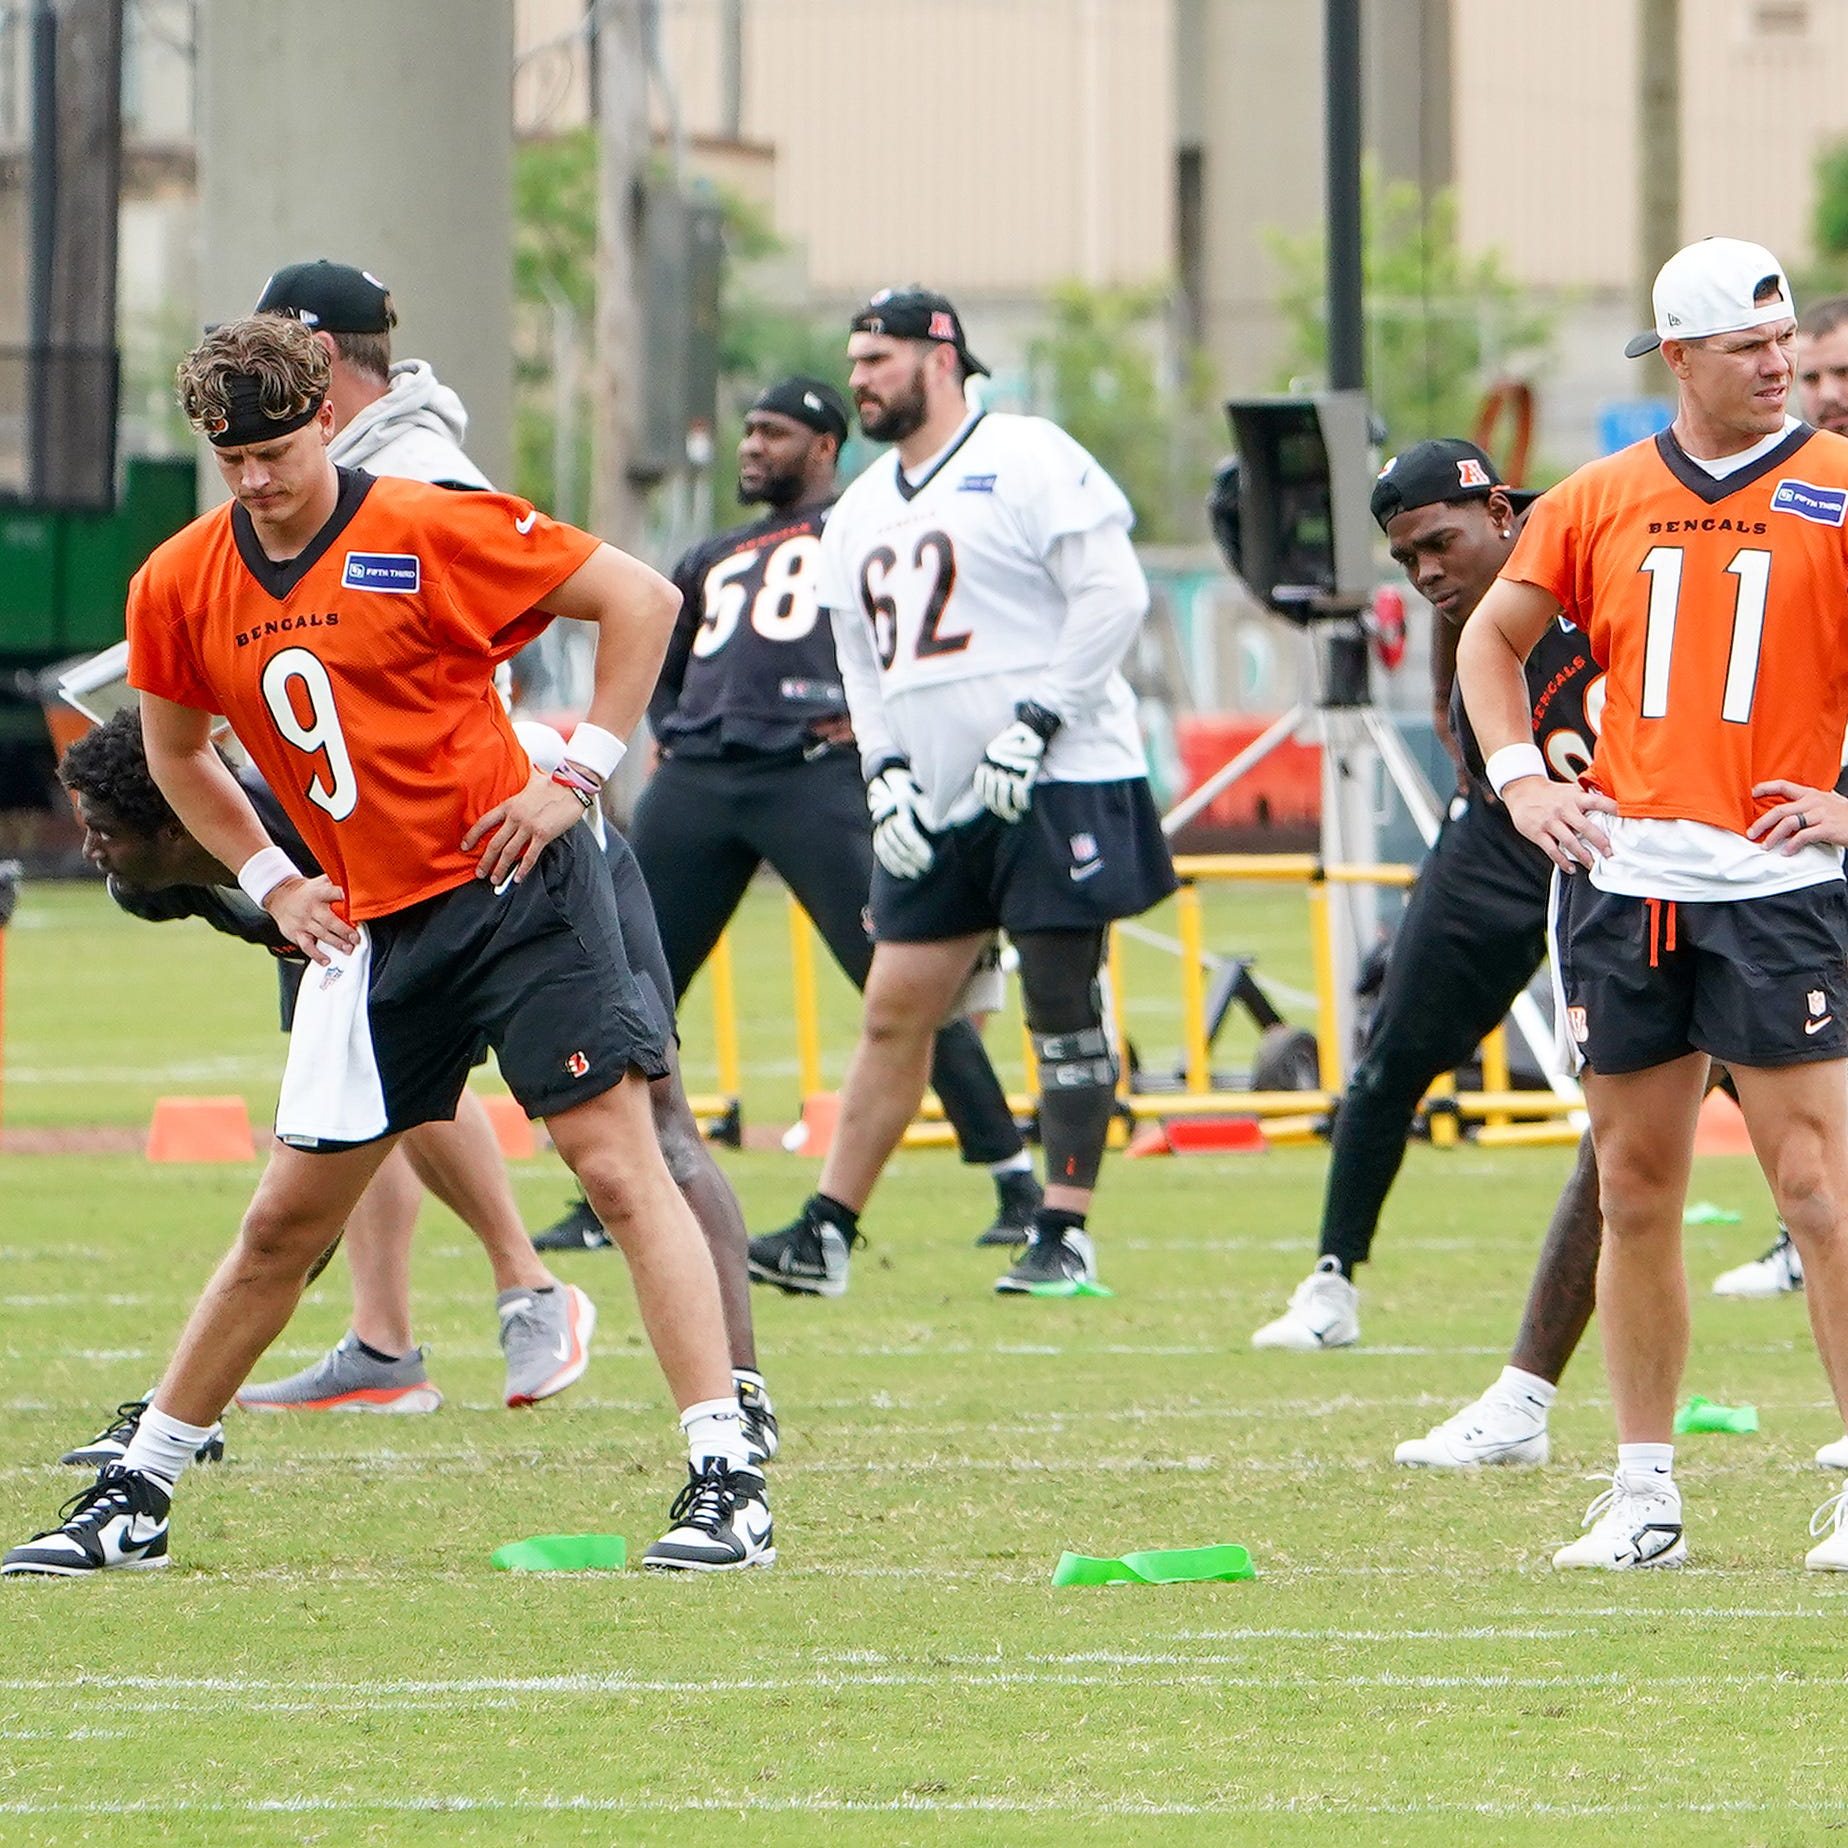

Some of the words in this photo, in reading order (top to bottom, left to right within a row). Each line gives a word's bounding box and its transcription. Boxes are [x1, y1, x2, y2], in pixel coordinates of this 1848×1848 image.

[1648, 518, 1768, 535] BENGALS
[235, 612, 340, 647] BENGALS
[692, 533, 823, 658] 58
[860, 529, 973, 672] 62
[1636, 545, 1773, 725] 11
[260, 645, 359, 822] 9
